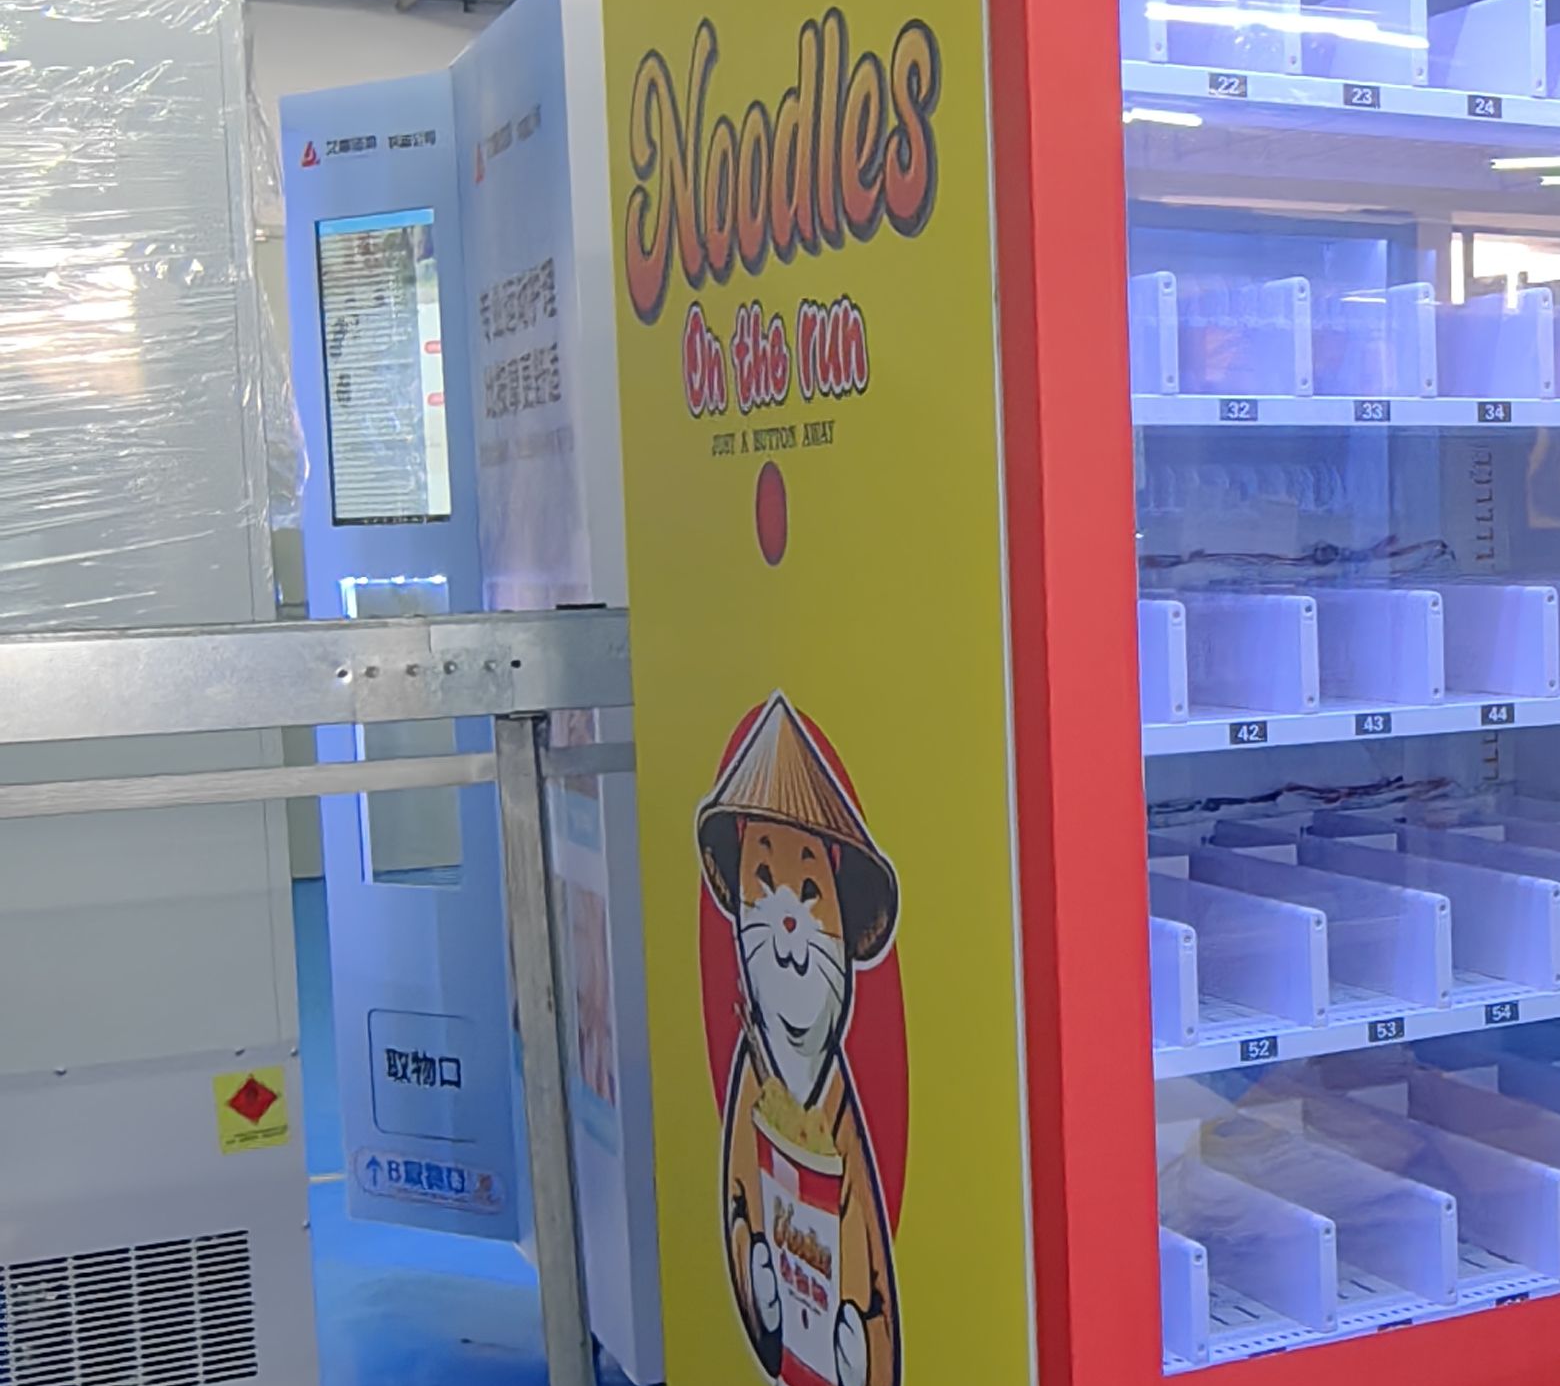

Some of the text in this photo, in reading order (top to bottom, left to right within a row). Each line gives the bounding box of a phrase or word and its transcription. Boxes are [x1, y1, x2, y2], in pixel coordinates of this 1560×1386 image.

[1353, 89, 1372, 104] 23
[1476, 99, 1494, 115] 24
[625, 6, 943, 326] Noodles
[682, 300, 728, 418] On
[731, 299, 791, 414] the
[798, 294, 870, 402] run
[1228, 403, 1250, 418] 32
[1363, 404, 1382, 419] 33
[1486, 405, 1505, 419] 34
[1489, 707, 1507, 721] 44
[1365, 716, 1383, 731] 43
[1238, 725, 1259, 741] 42
[1493, 1005, 1512, 1020] 54
[1377, 1022, 1396, 1038] 53
[1249, 1041, 1270, 1058] 52
